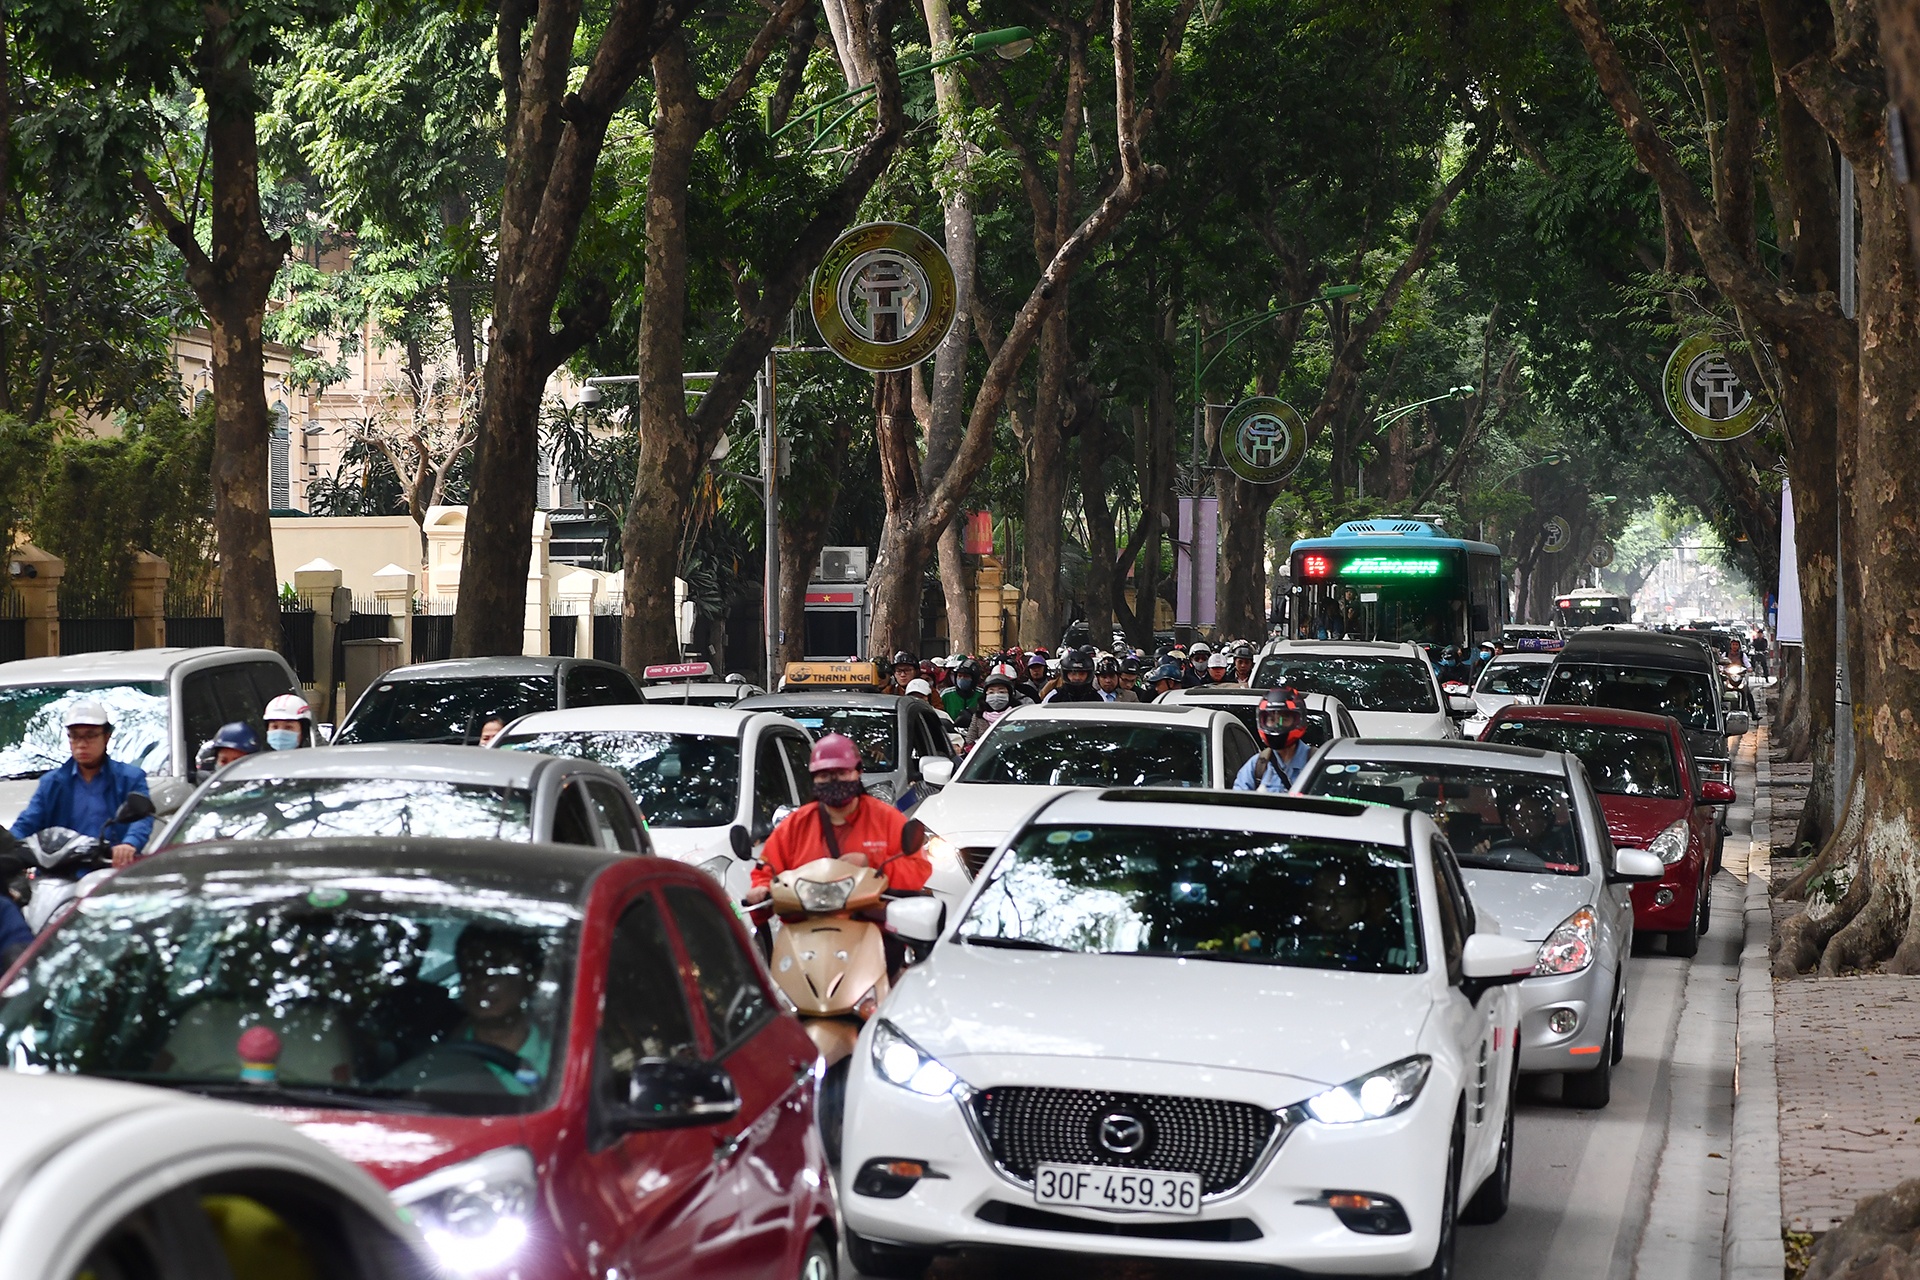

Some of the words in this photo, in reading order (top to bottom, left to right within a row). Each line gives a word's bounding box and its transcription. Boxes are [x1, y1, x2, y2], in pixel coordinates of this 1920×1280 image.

[1307, 557, 1326, 574] 14
[664, 665, 690, 674] TAXI
[812, 674, 844, 682] THANH
[849, 674, 871, 682] NGA
[1041, 1170, 1195, 1208] 30F-459.36
